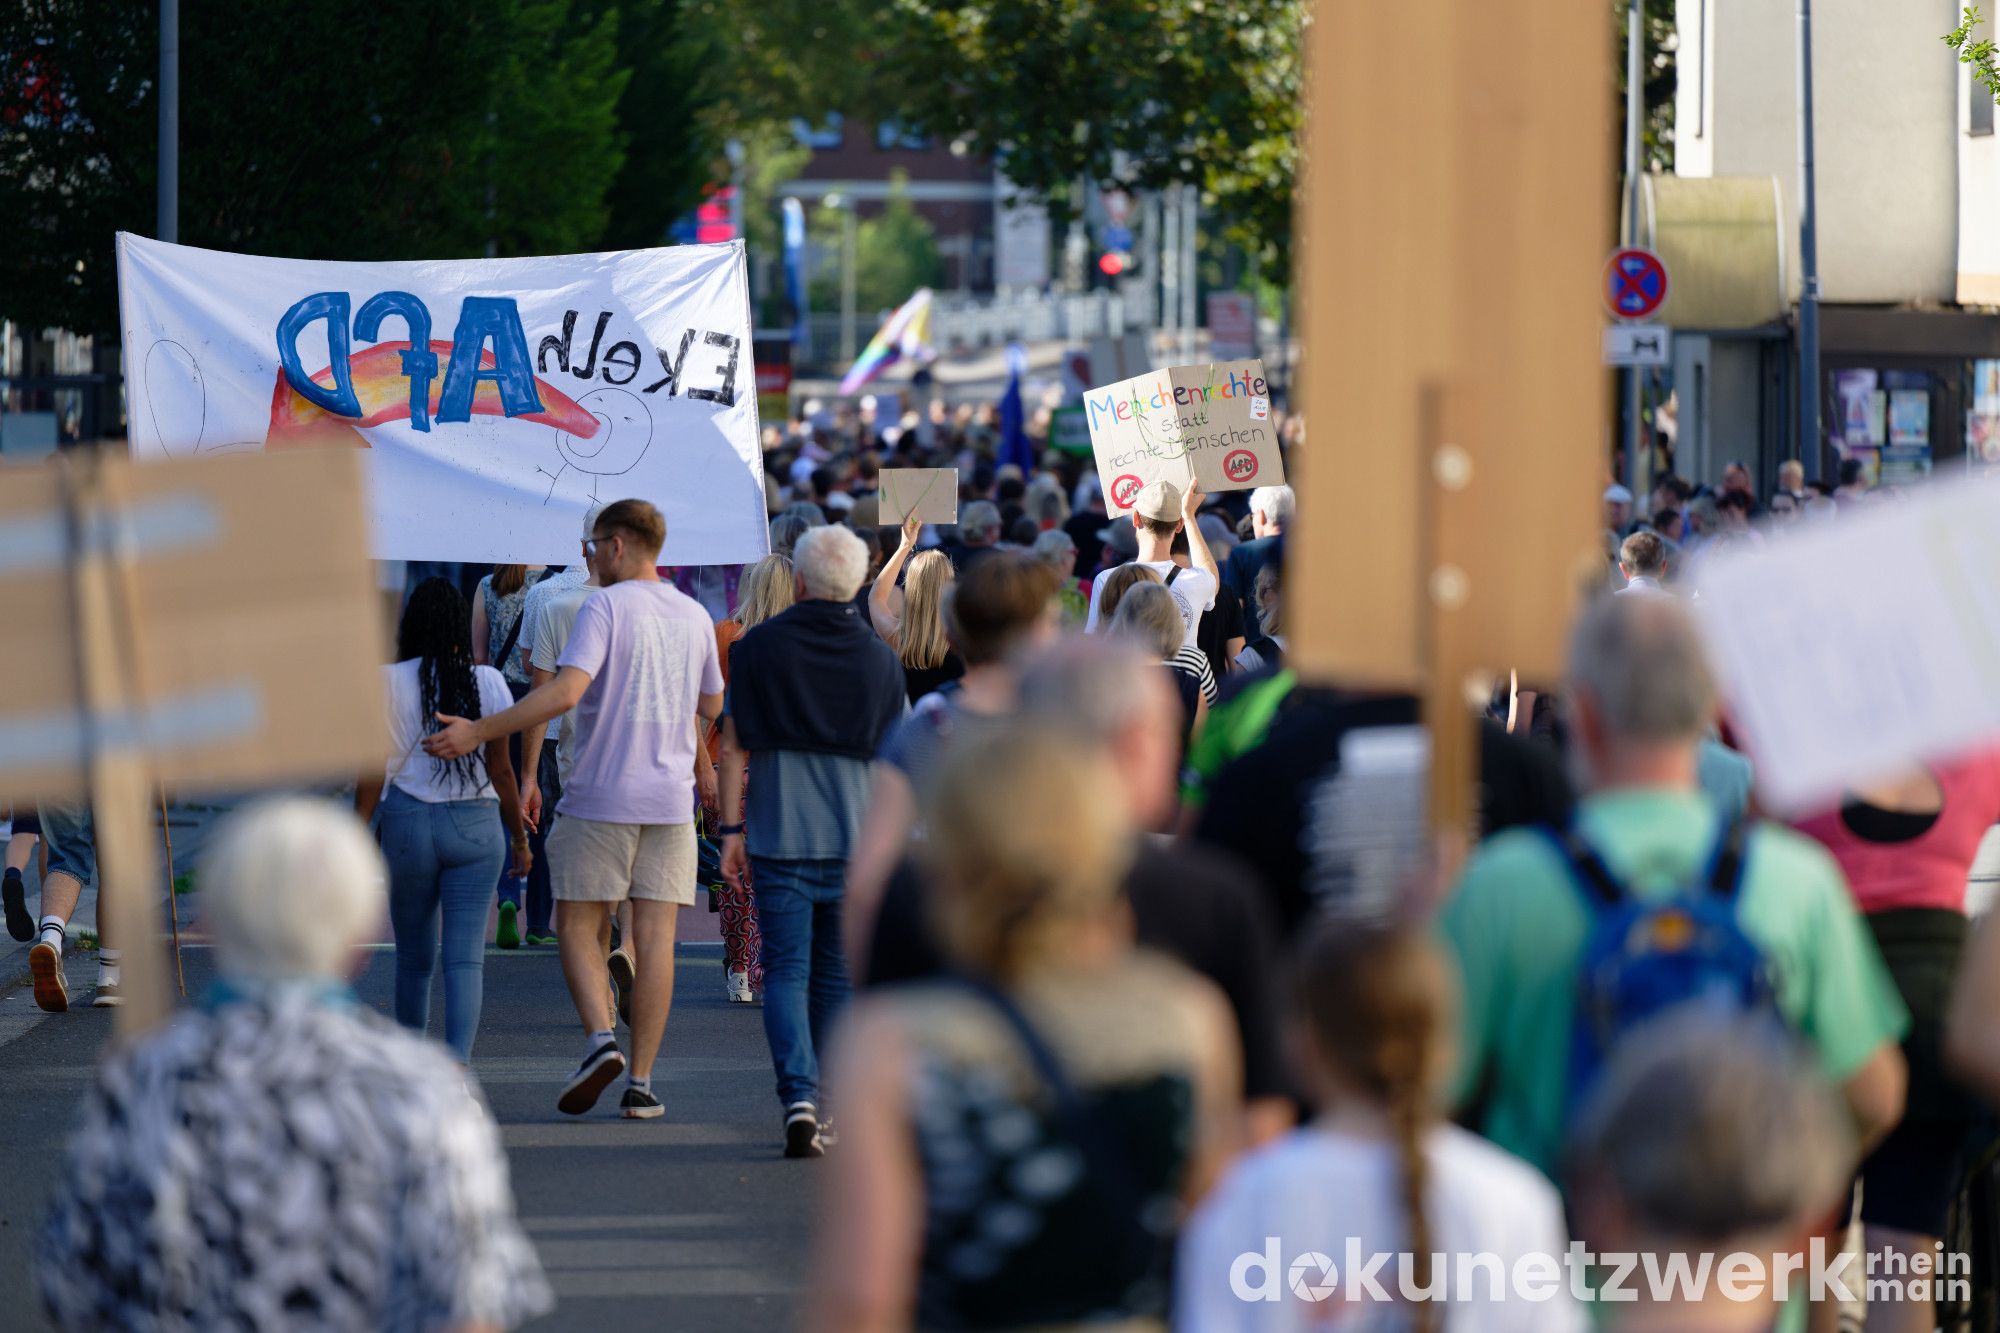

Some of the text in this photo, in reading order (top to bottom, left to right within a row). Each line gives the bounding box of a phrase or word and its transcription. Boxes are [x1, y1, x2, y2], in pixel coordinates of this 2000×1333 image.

[1088, 369, 1268, 432] Menschenrechte
[1161, 411, 1209, 433] statt
[1108, 424, 1266, 471] rechte Menschen
